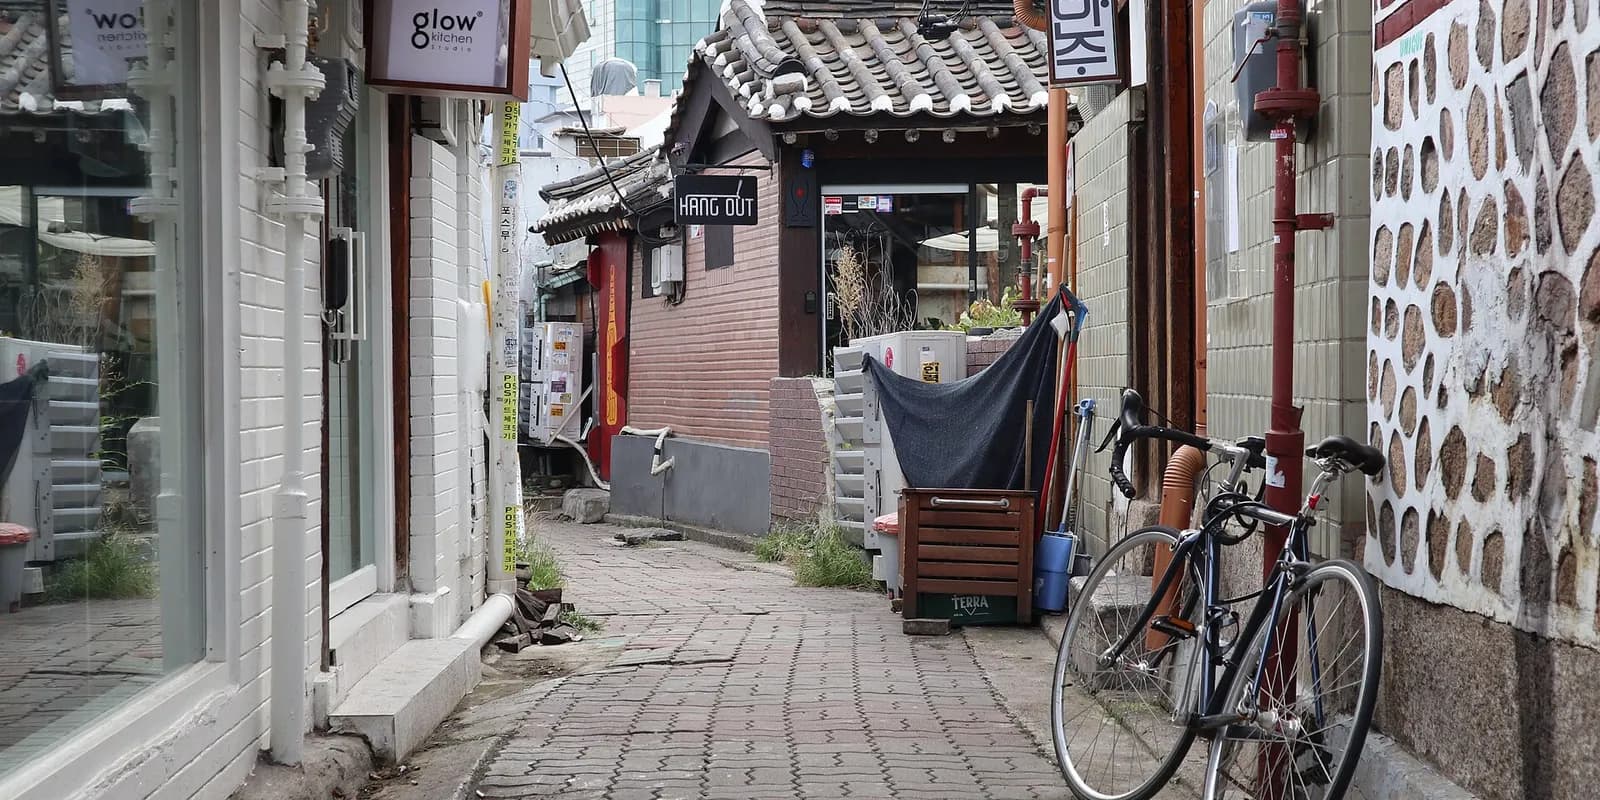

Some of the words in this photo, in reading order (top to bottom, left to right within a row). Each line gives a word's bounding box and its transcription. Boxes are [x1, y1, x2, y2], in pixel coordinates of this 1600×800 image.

[431, 32, 473, 44] kitchen
[679, 194, 719, 217] HANG
[725, 197, 754, 217] OUT
[951, 594, 989, 611] TERRA
